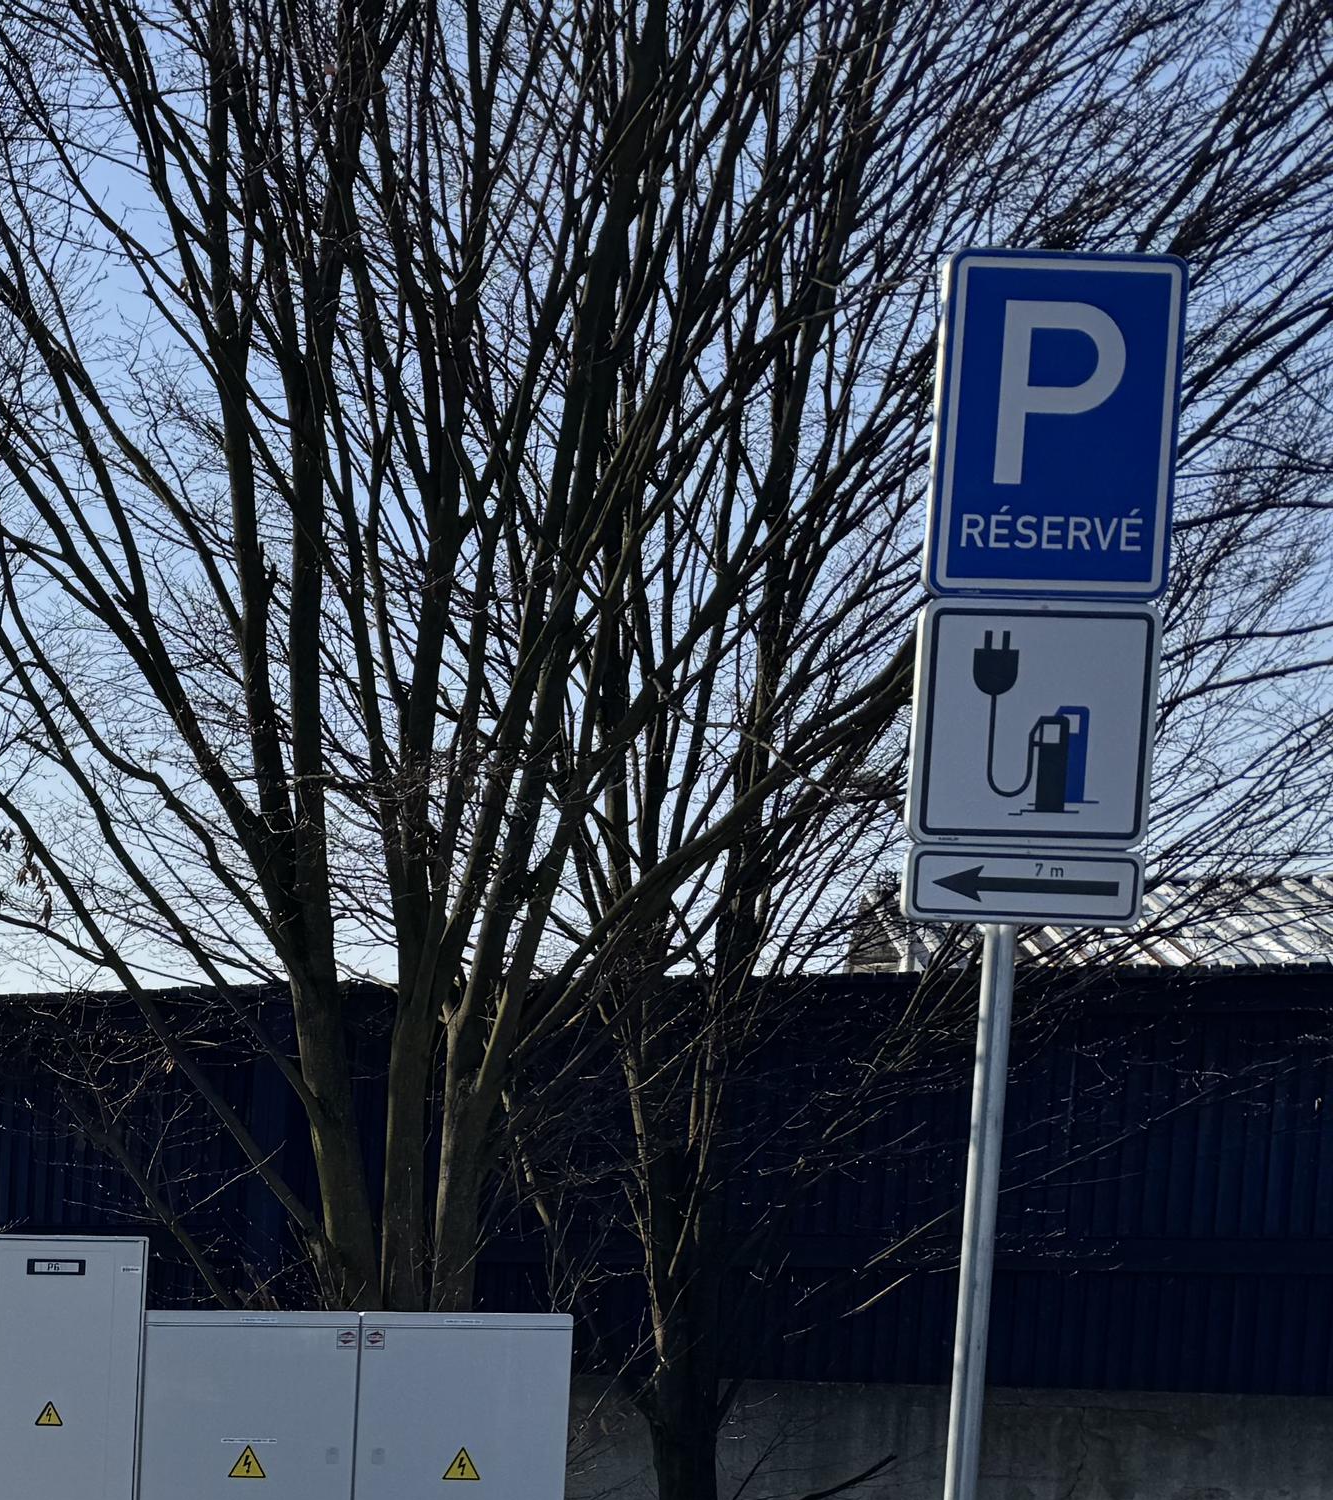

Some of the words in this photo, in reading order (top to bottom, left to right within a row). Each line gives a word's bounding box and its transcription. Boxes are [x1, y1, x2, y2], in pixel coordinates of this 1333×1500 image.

[993, 298, 1127, 485] P
[959, 505, 1144, 552] RÉSERVÉ
[1035, 864, 1045, 877] 7
[1050, 867, 1065, 878] m
